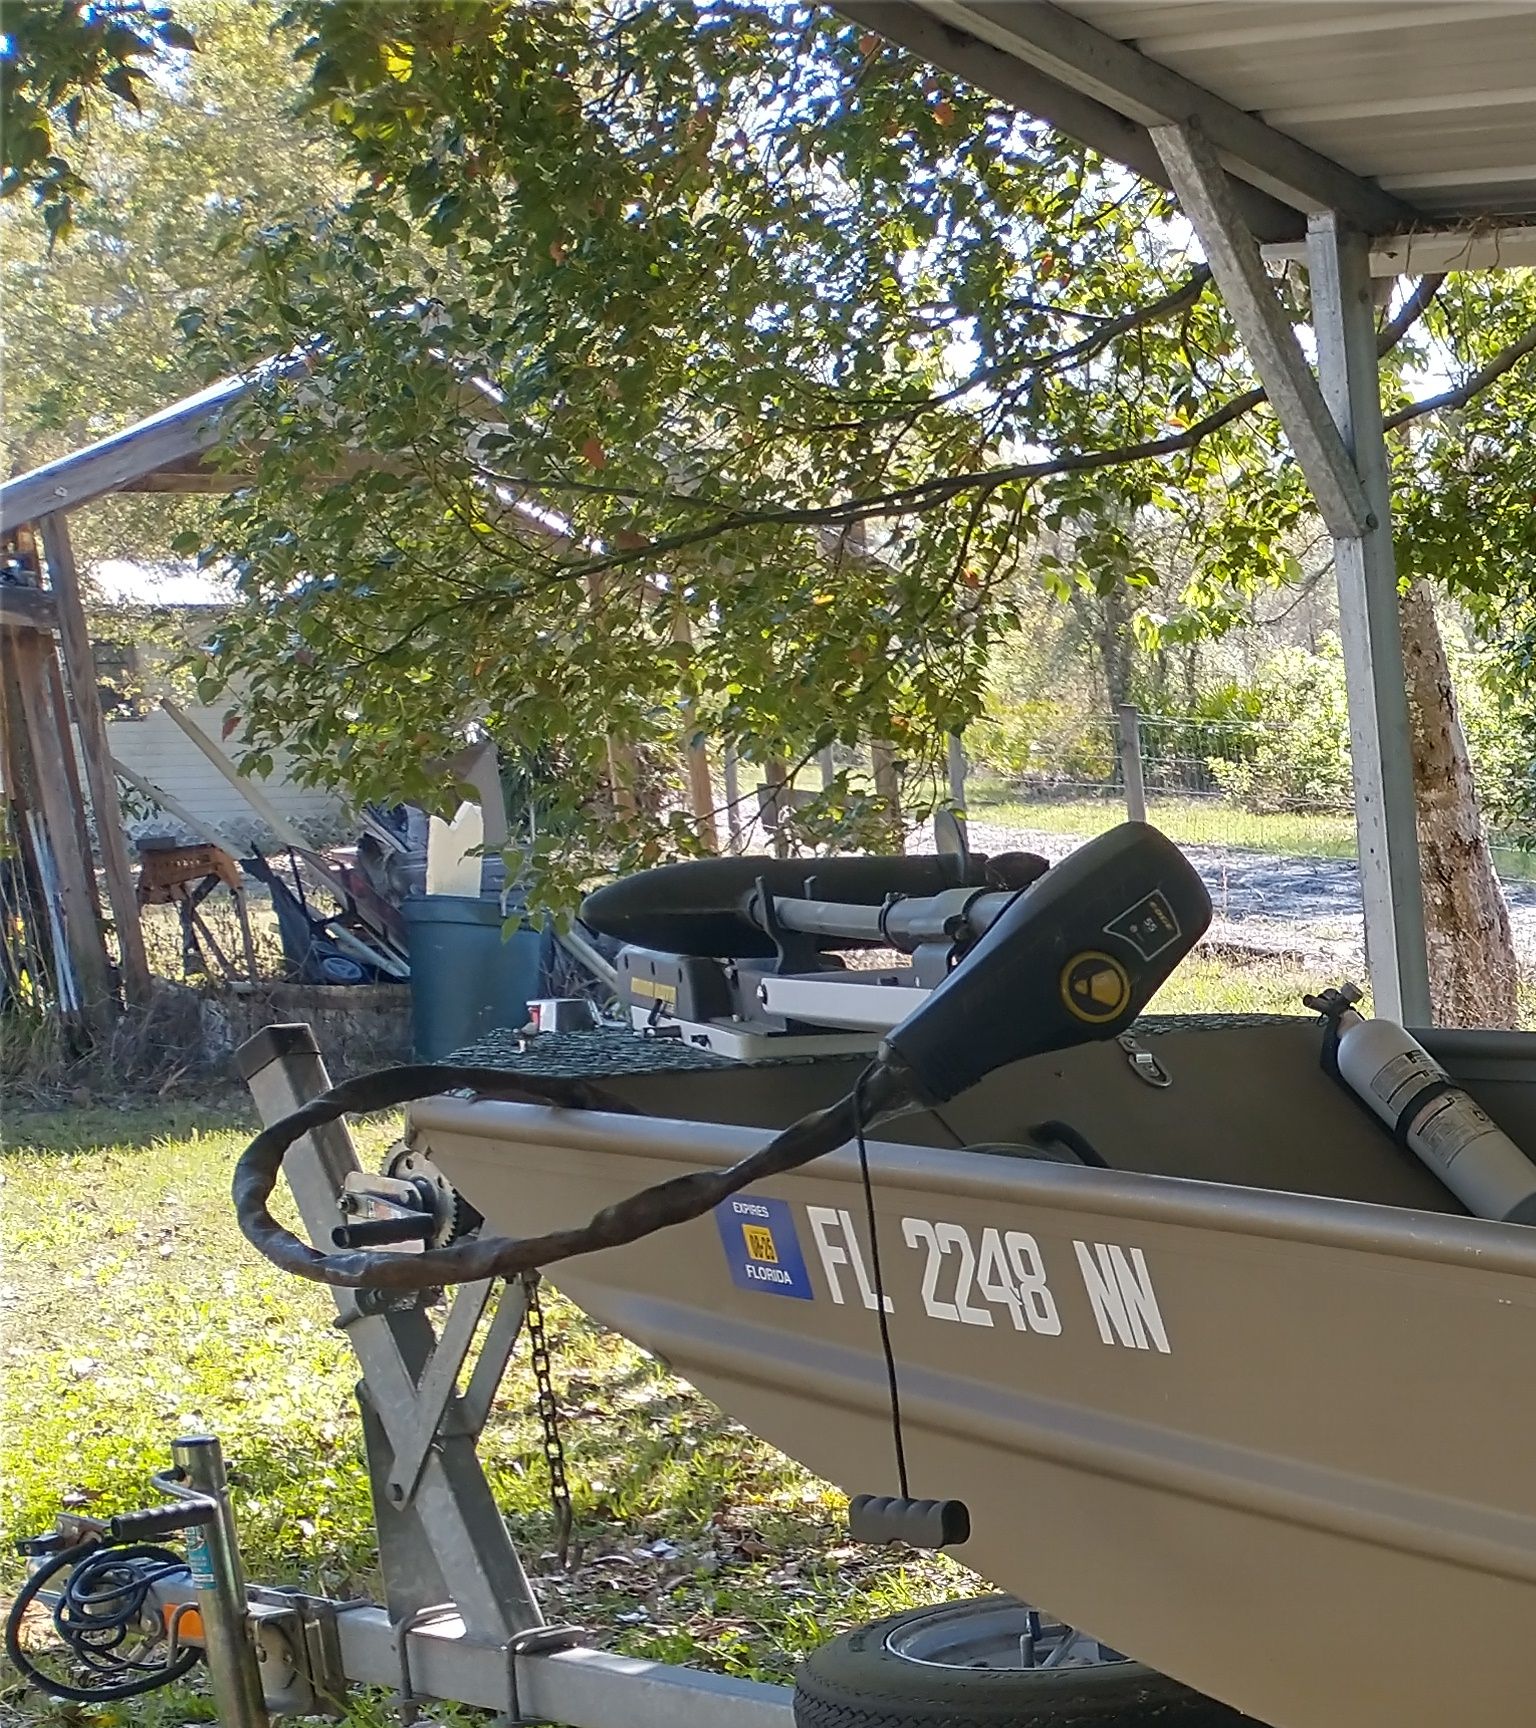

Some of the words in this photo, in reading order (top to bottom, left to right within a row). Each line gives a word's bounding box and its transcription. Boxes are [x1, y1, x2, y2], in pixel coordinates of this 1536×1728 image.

[732, 1202, 770, 1218] EXPIRES
[745, 1264, 793, 1285] FLORIDA
[806, 1205, 894, 1313] FL
[902, 1217, 1062, 1336] 2248
[1072, 1240, 1171, 1354] NN
